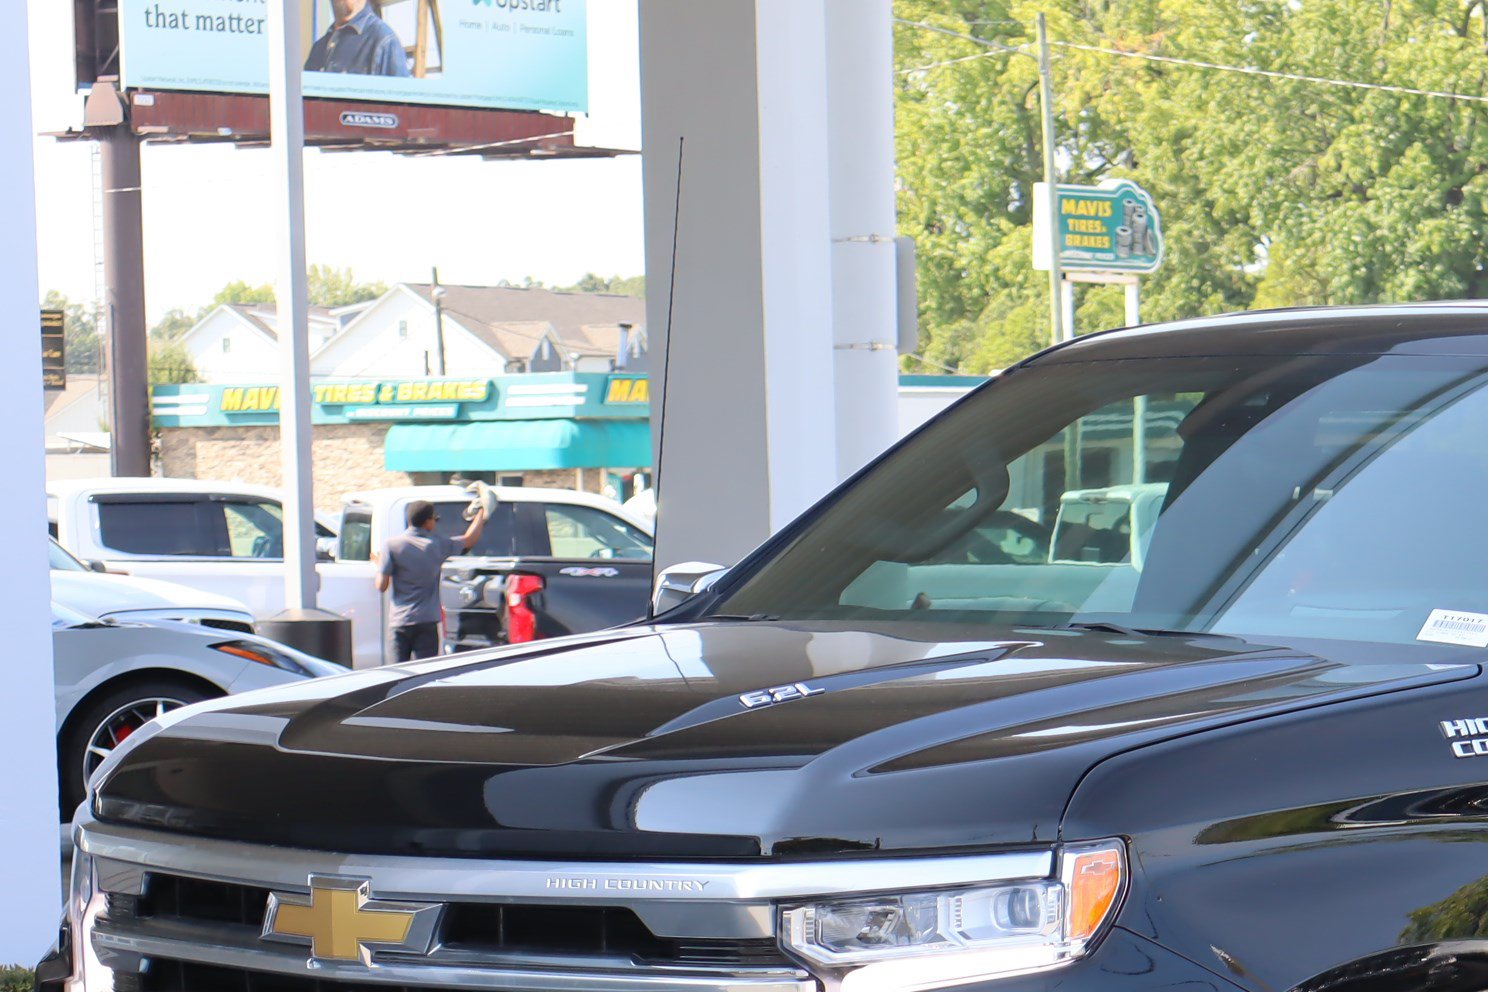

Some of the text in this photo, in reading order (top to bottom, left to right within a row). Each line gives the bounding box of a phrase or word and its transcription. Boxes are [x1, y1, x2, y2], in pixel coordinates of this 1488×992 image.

[144, 4, 266, 35] that matter
[343, 114, 394, 126] ADAMS
[1061, 198, 1113, 217] MAVIS
[1067, 218, 1103, 233] TIRES
[1065, 234, 1111, 249] BRAKES
[313, 383, 375, 403] TIRES
[378, 383, 396, 403] &
[396, 380, 488, 401] BRAKES
[545, 877, 710, 892] HIGH COUNTRY
